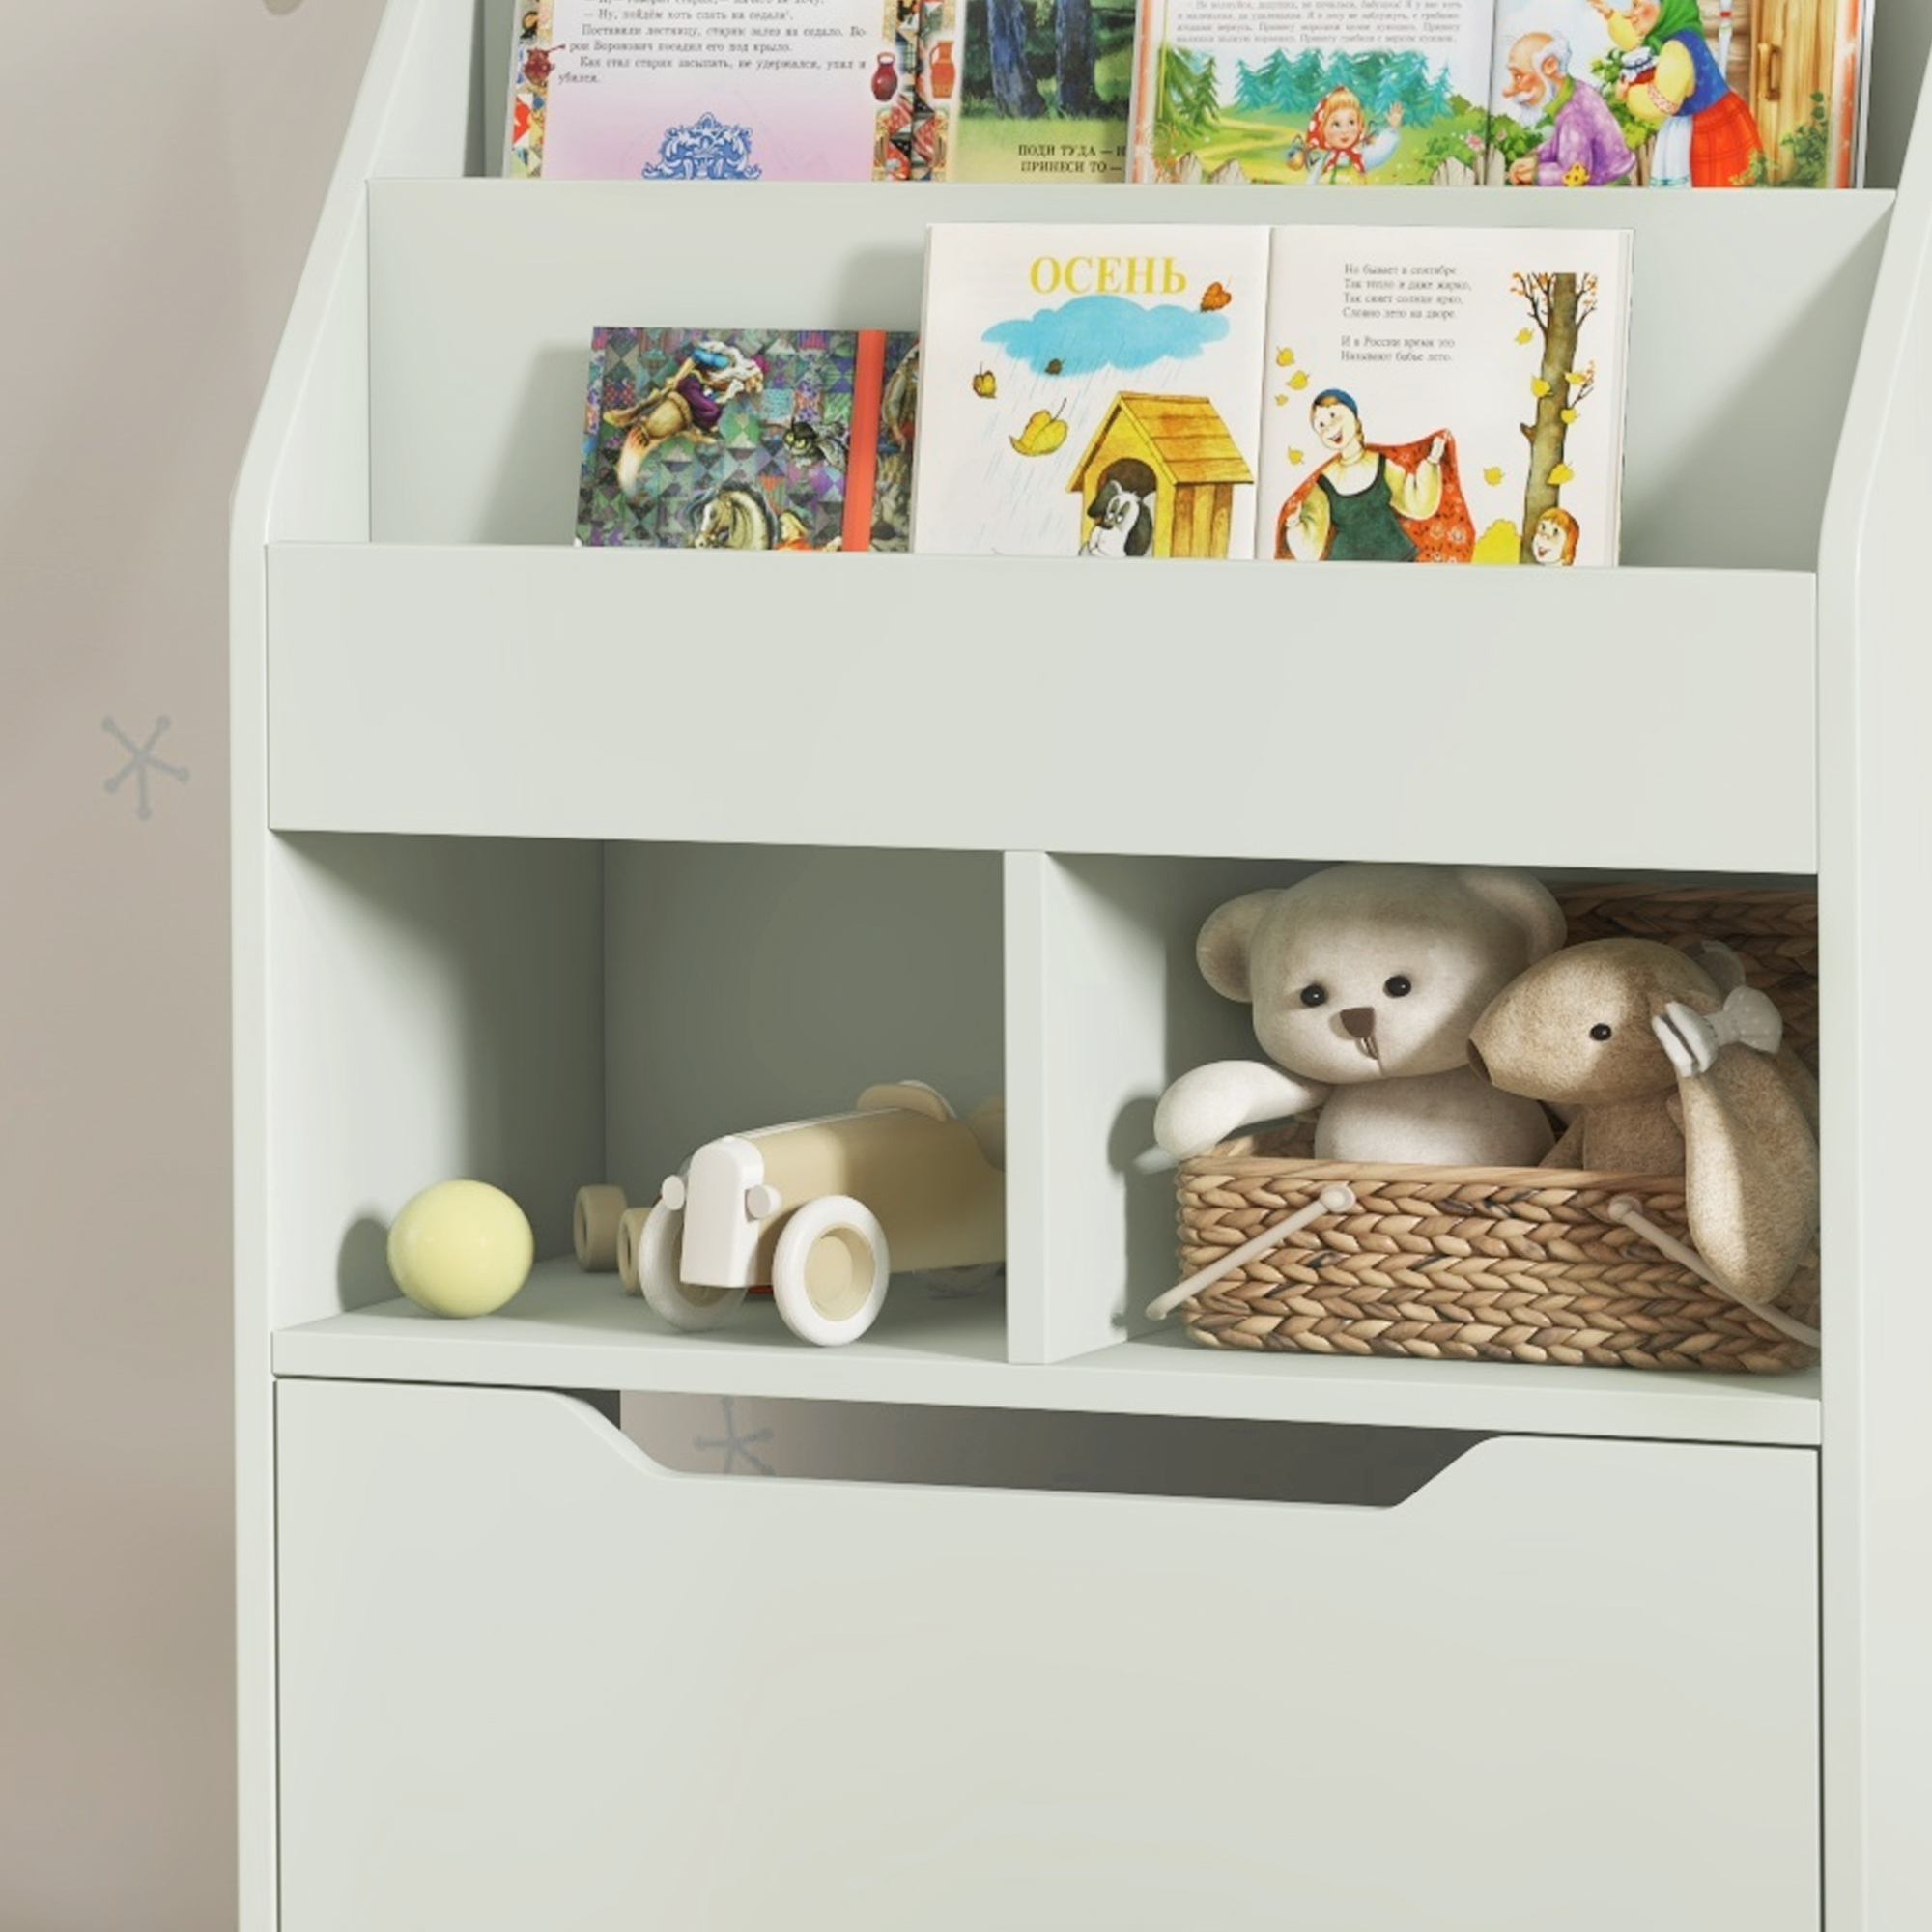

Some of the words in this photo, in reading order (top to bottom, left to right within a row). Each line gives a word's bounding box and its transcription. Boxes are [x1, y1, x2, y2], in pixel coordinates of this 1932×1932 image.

[1018, 145, 1055, 157] ПОДИ
[1060, 145, 1096, 157] ТУДА
[1021, 161, 1084, 173] ПРИНЕСИ
[1089, 162, 1107, 173] ТО
[1030, 255, 1188, 294] ОСЕНЬ
